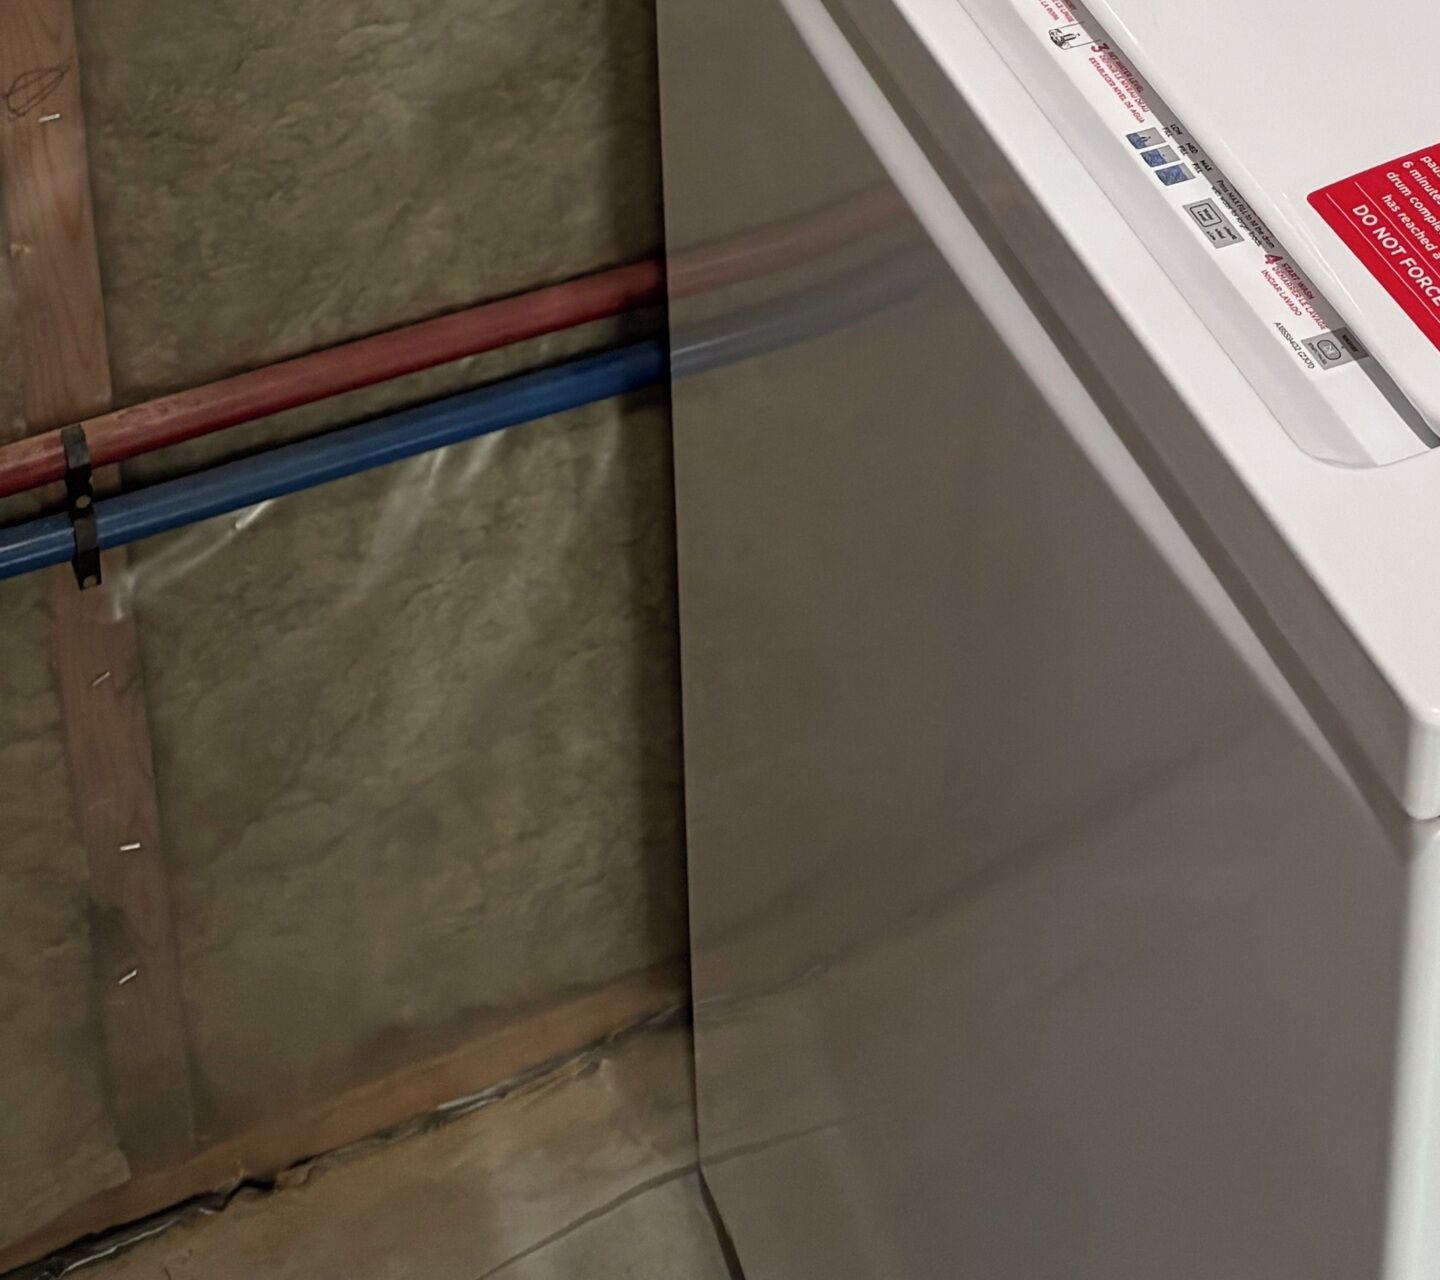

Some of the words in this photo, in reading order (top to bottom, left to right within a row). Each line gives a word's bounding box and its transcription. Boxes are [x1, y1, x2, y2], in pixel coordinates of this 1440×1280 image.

[1090, 42, 1110, 53] 3
[1200, 160, 1213, 171] MAX
[1402, 160, 1413, 169] 6
[1386, 171, 1412, 197] drum
[1352, 204, 1378, 226] DO
[1372, 226, 1407, 256] NOT
[1381, 194, 1401, 213] has
[1398, 212, 1438, 252] reached
[1265, 254, 1283, 264] 4
[1261, 269, 1283, 293] INICIAR
[1280, 291, 1302, 317] LAVADO
[1281, 262, 1300, 282] START
[1297, 280, 1315, 300] WASH
[1298, 296, 1308, 307] LE
[1305, 305, 1329, 330] LAVAGE
